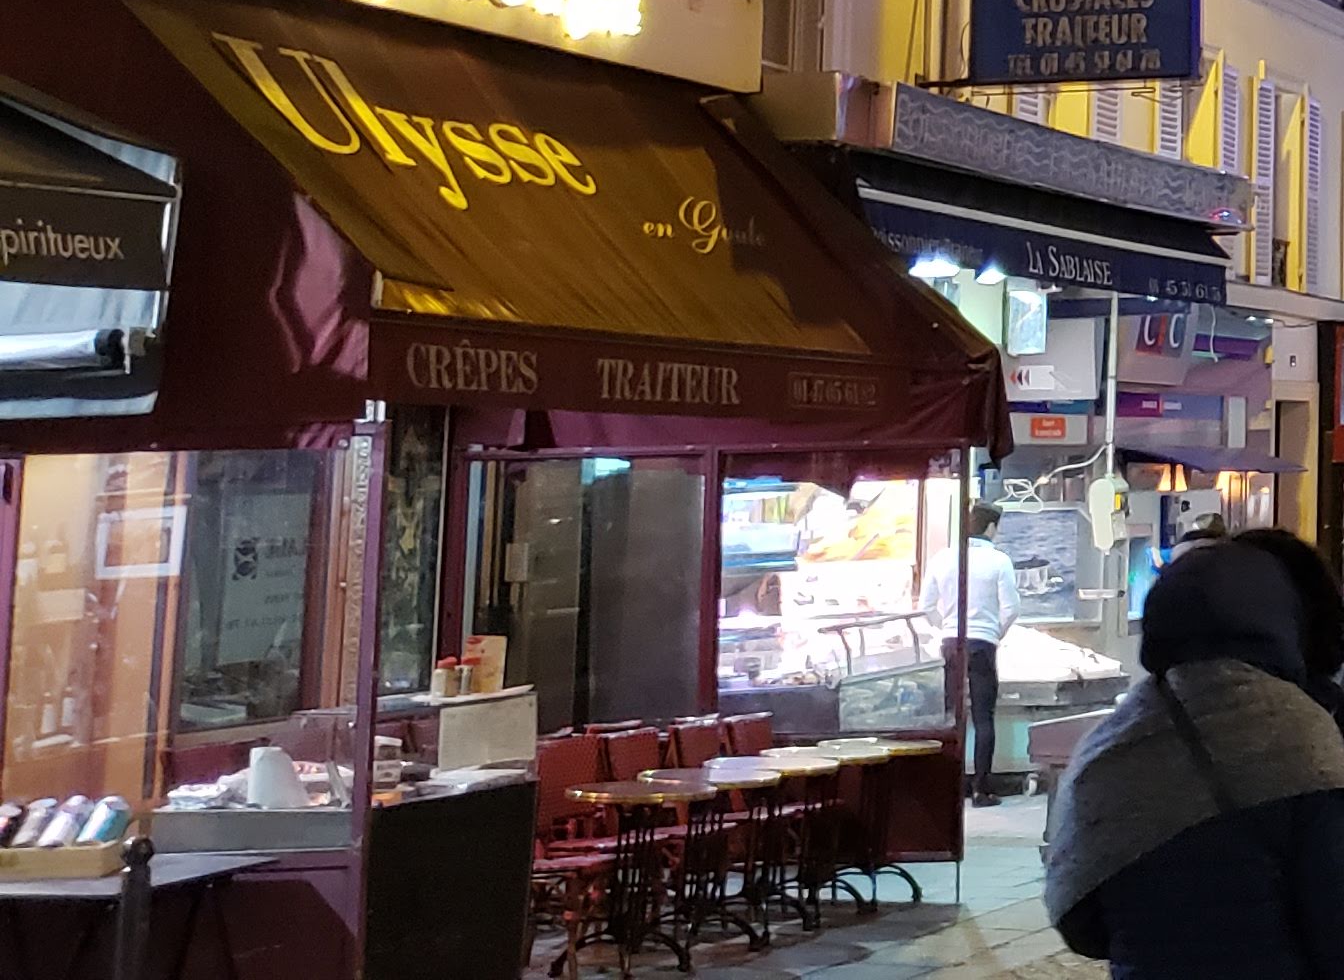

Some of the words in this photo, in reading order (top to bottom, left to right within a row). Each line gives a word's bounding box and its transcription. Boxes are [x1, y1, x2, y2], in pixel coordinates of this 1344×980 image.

[1022, 13, 1148, 48] TRAITEUR
[210, 30, 597, 210] Ulysse
[643, 221, 674, 239] en
[406, 338, 540, 396] CRÊPES
[597, 358, 741, 406] TRAITEUR
